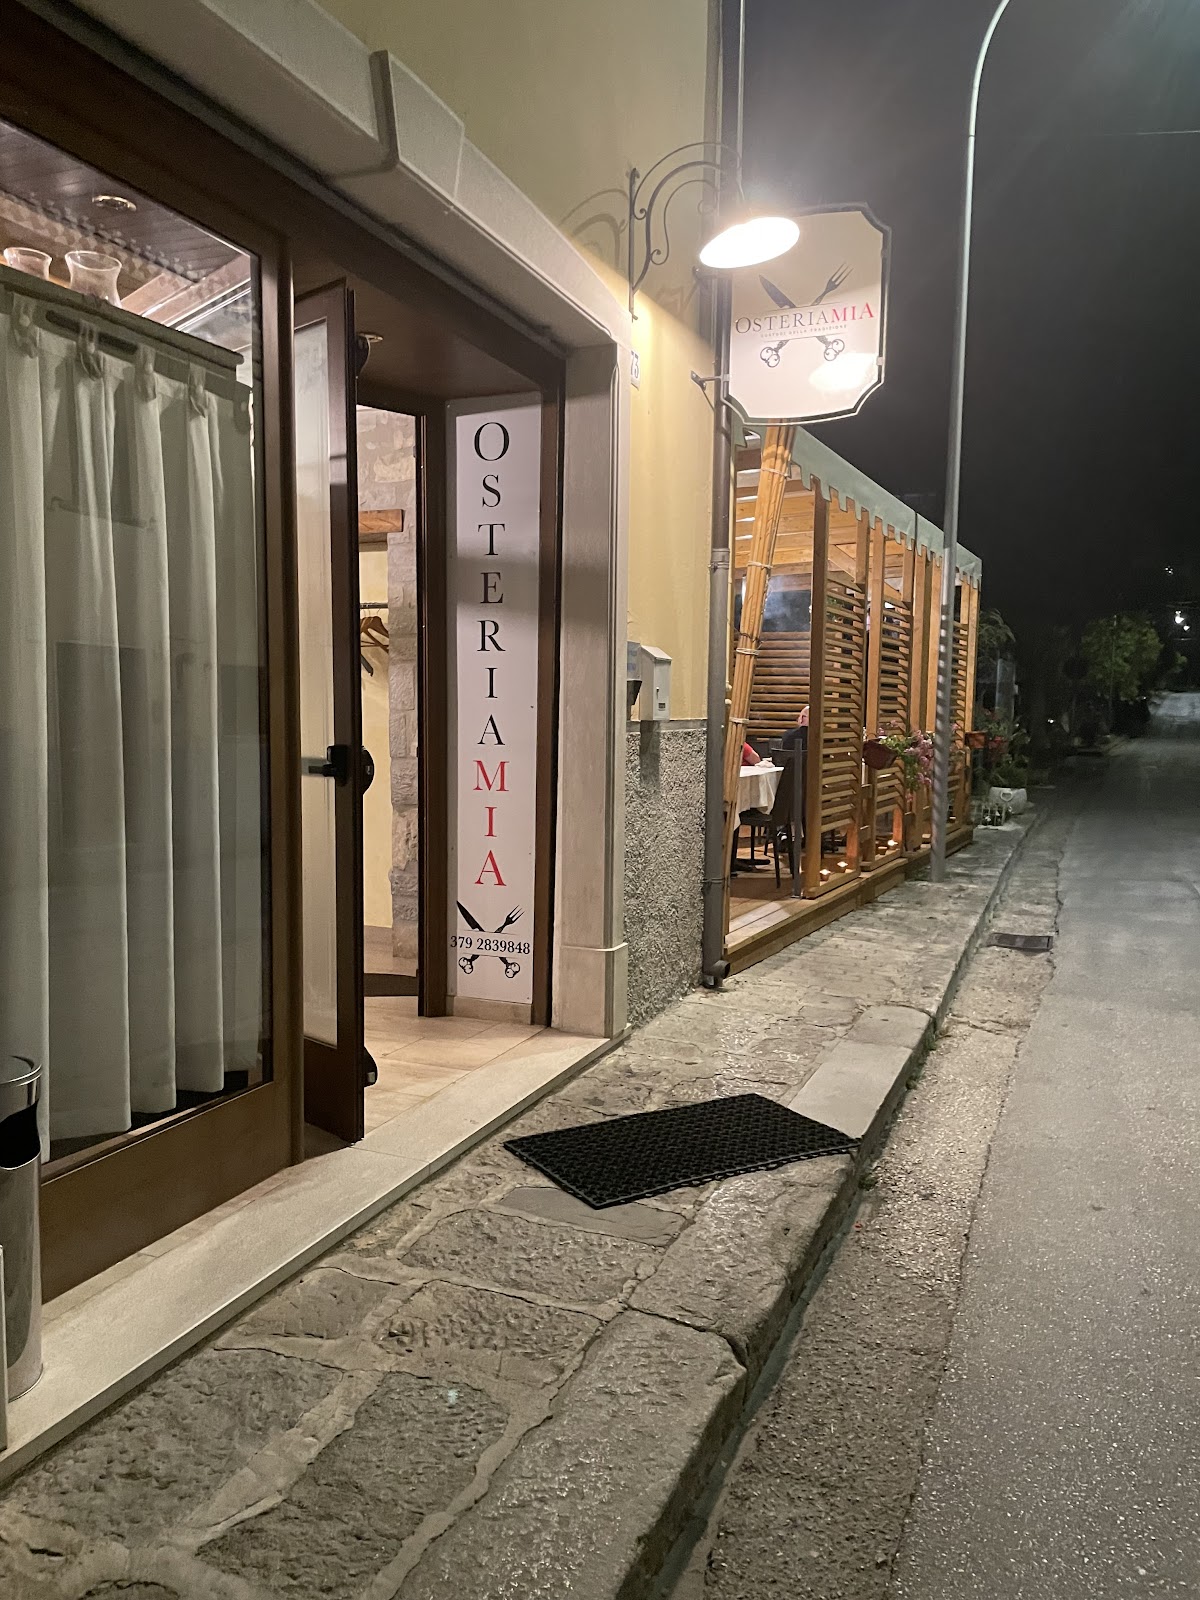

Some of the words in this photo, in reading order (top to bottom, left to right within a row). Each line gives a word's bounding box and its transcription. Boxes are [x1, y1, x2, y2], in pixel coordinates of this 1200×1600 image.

[735, 302, 875, 334] OSTERIAMIA
[450, 935, 473, 949] 379
[476, 937, 531, 955] 2839848
